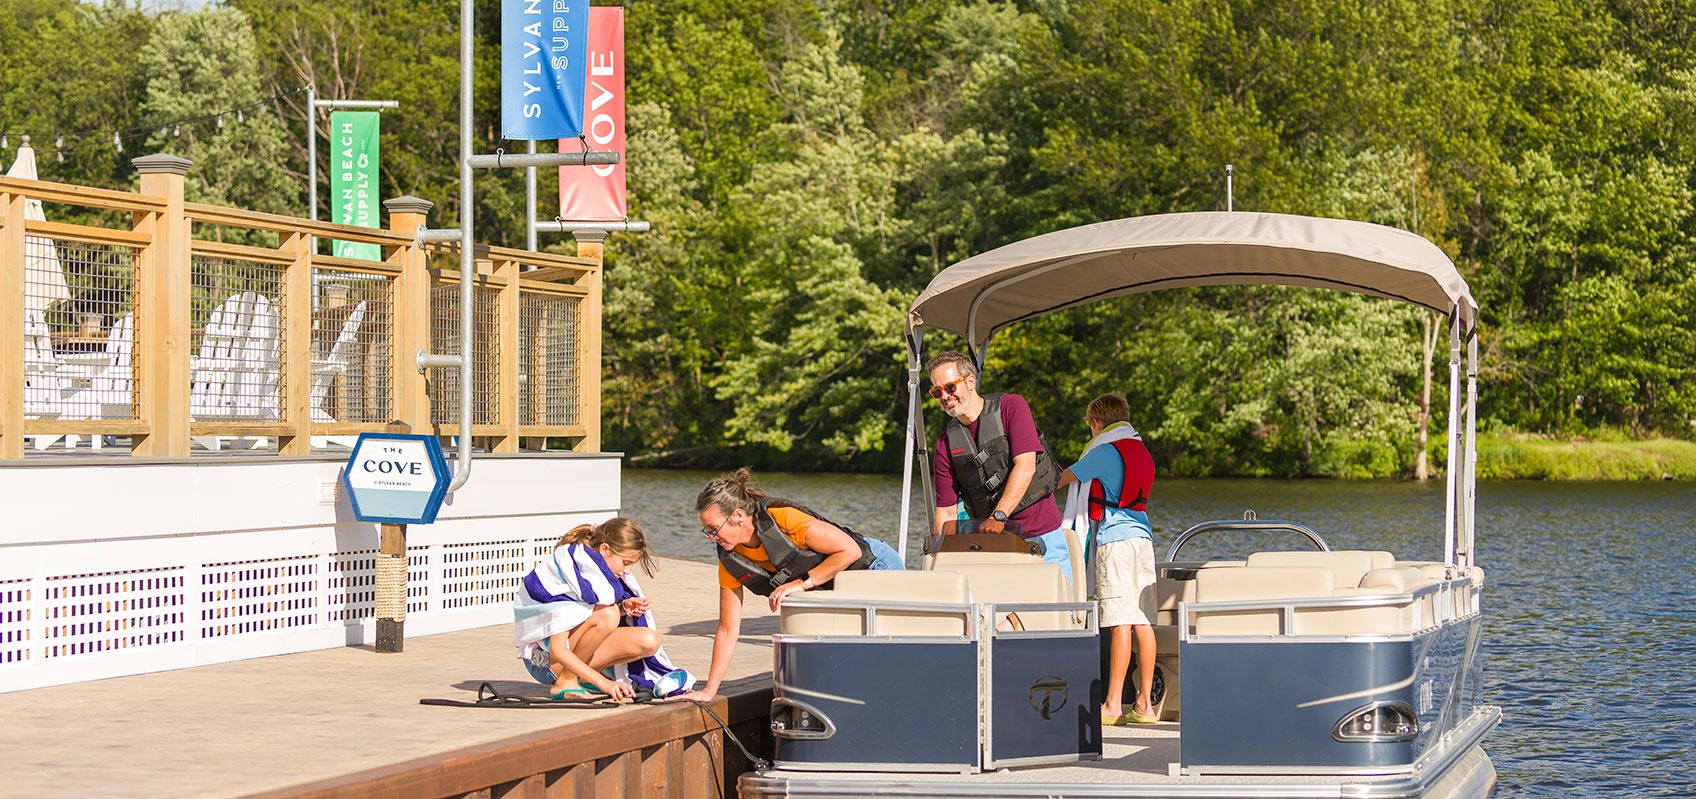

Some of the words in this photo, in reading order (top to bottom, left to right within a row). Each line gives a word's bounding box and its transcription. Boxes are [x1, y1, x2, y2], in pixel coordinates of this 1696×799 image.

[524, 0, 541, 118] SYLVAN
[552, 0, 570, 70] SUPP
[342, 123, 353, 181] BEACH
[363, 459, 422, 475] COVE
